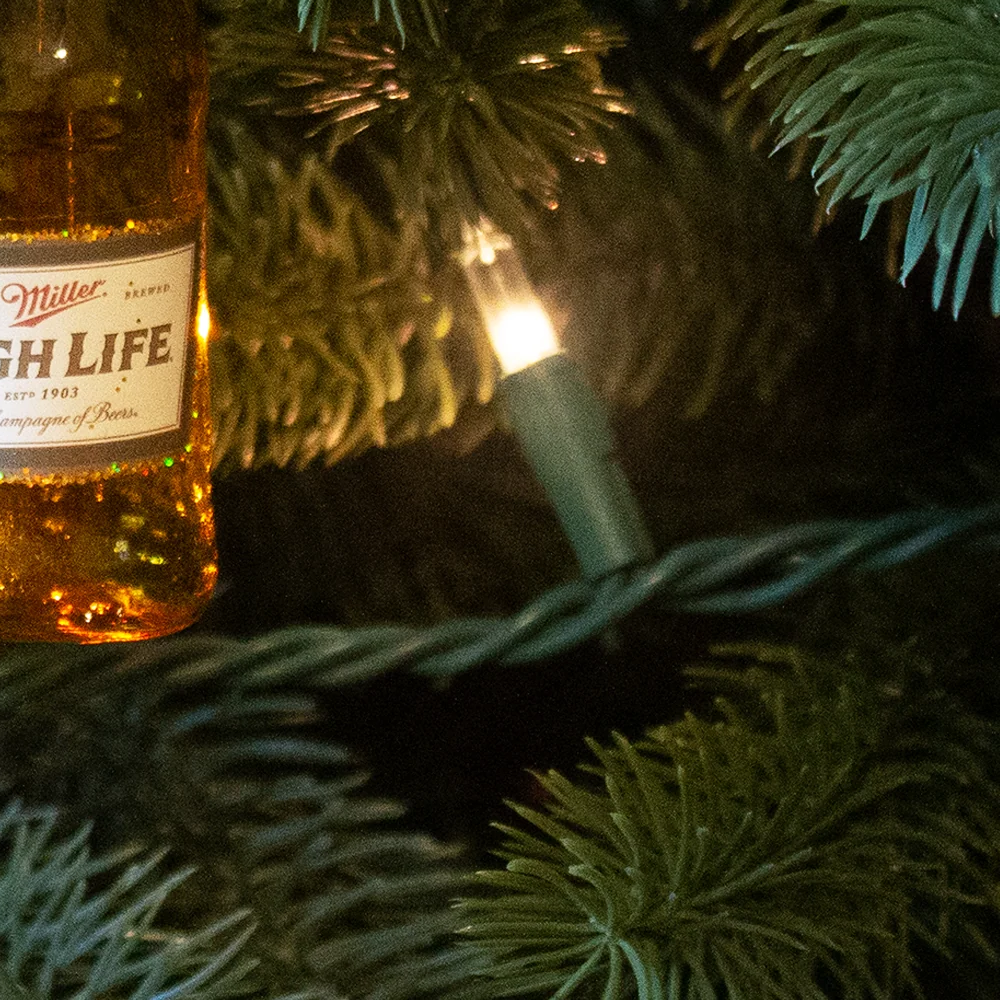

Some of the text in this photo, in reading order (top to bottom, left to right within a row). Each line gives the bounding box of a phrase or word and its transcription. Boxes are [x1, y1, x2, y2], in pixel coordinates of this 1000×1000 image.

[0, 279, 107, 328] Miller
[124, 283, 171, 300] BREWED
[63, 322, 174, 378] LIFE
[41, 386, 80, 400] 1903
[69, 406, 93, 433] of
